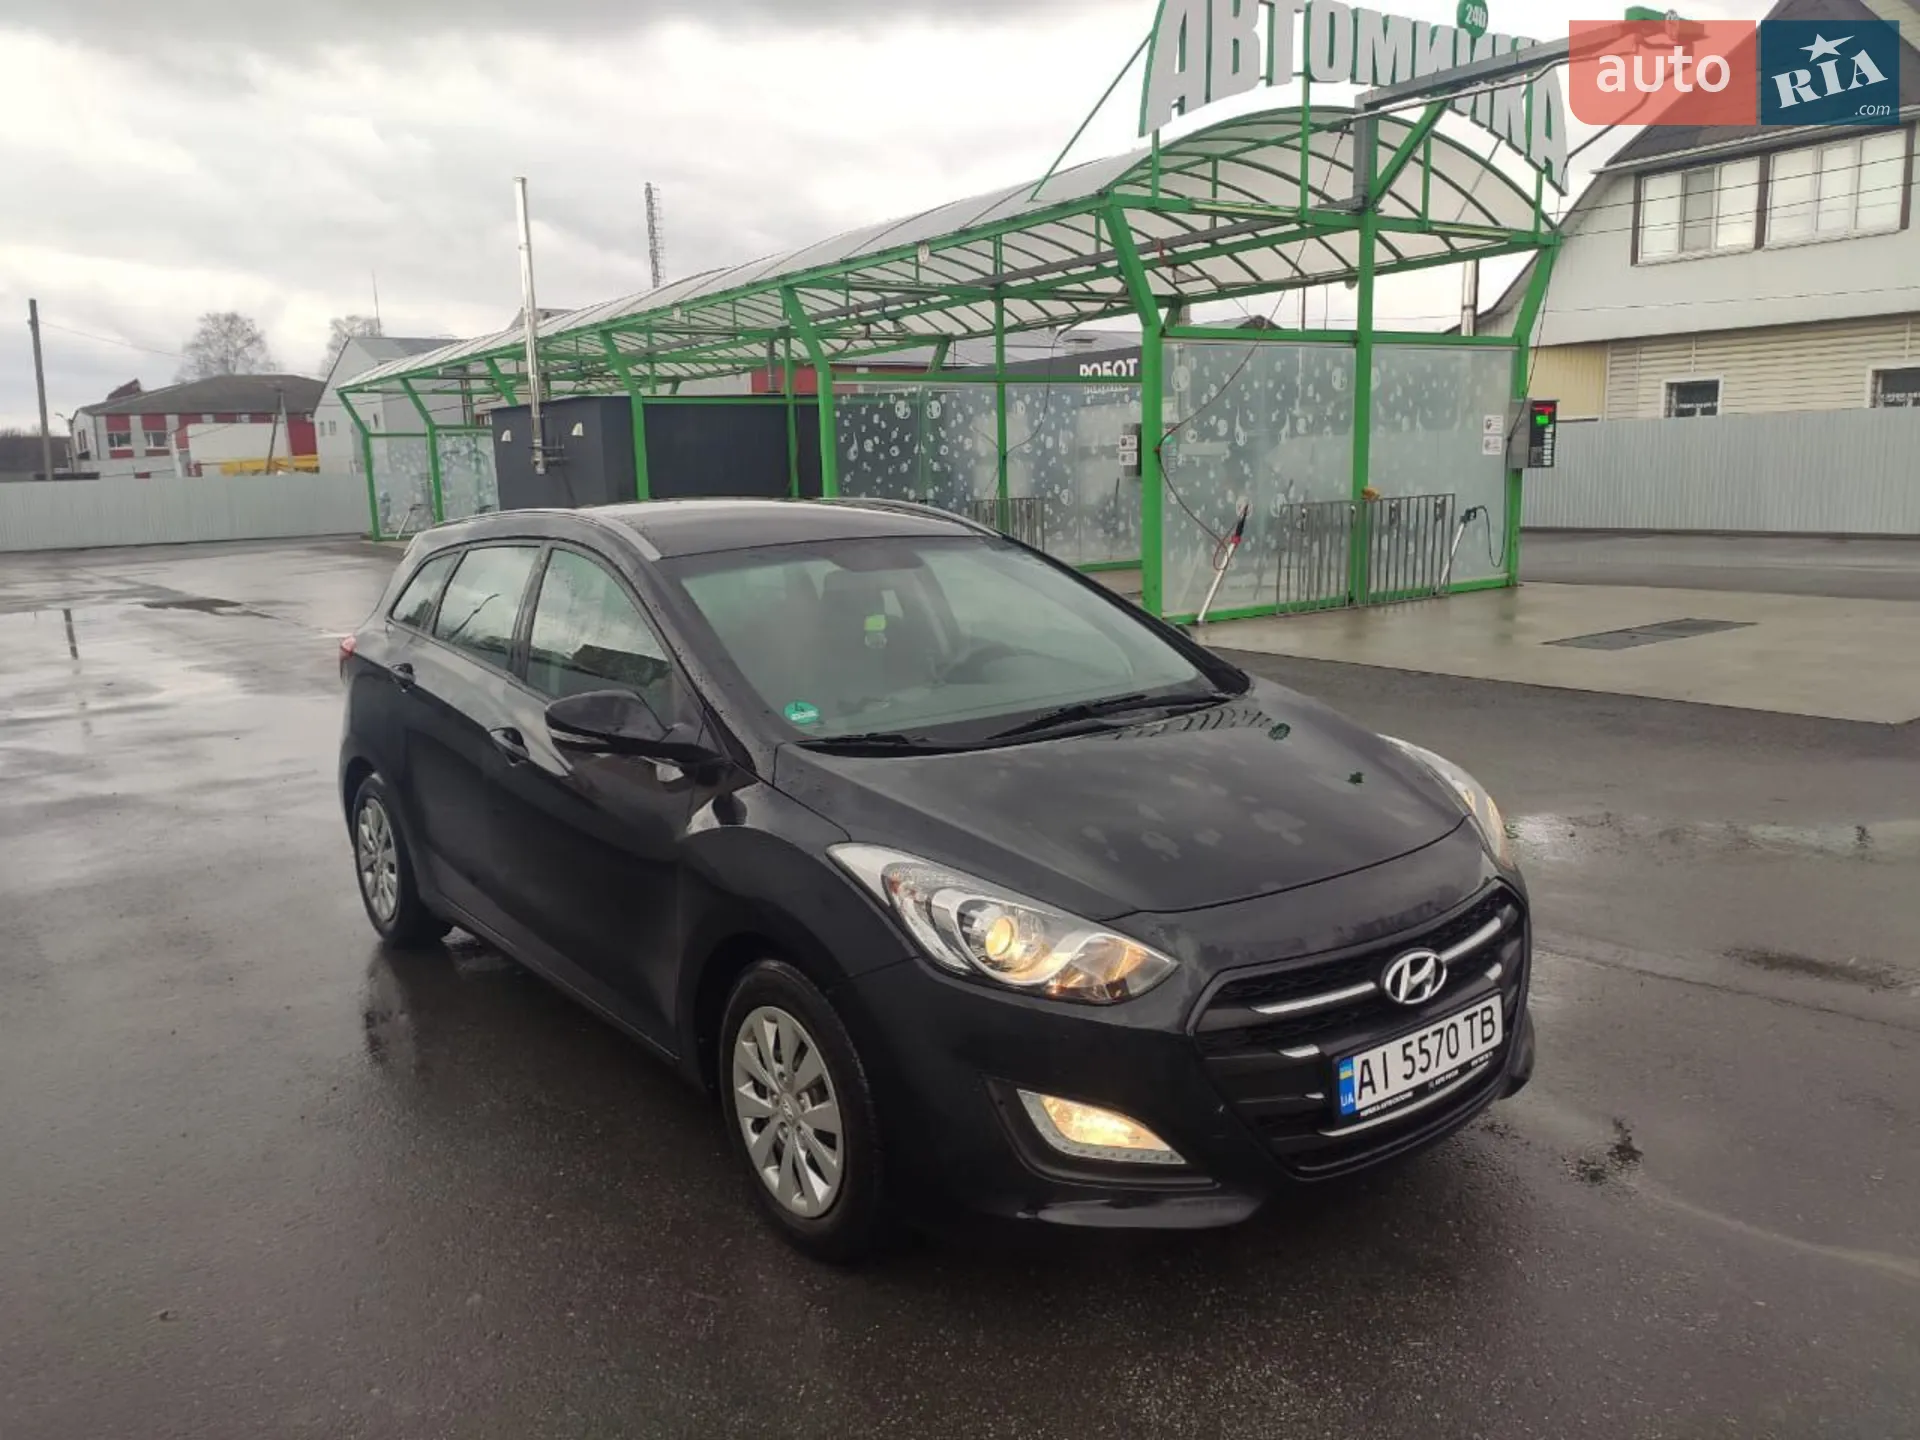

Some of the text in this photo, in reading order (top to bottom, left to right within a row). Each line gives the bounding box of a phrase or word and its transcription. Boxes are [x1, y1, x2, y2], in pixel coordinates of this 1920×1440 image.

[1358, 1005, 1495, 1100] AI 5570 TB
[1340, 1092, 1354, 1107] UA
